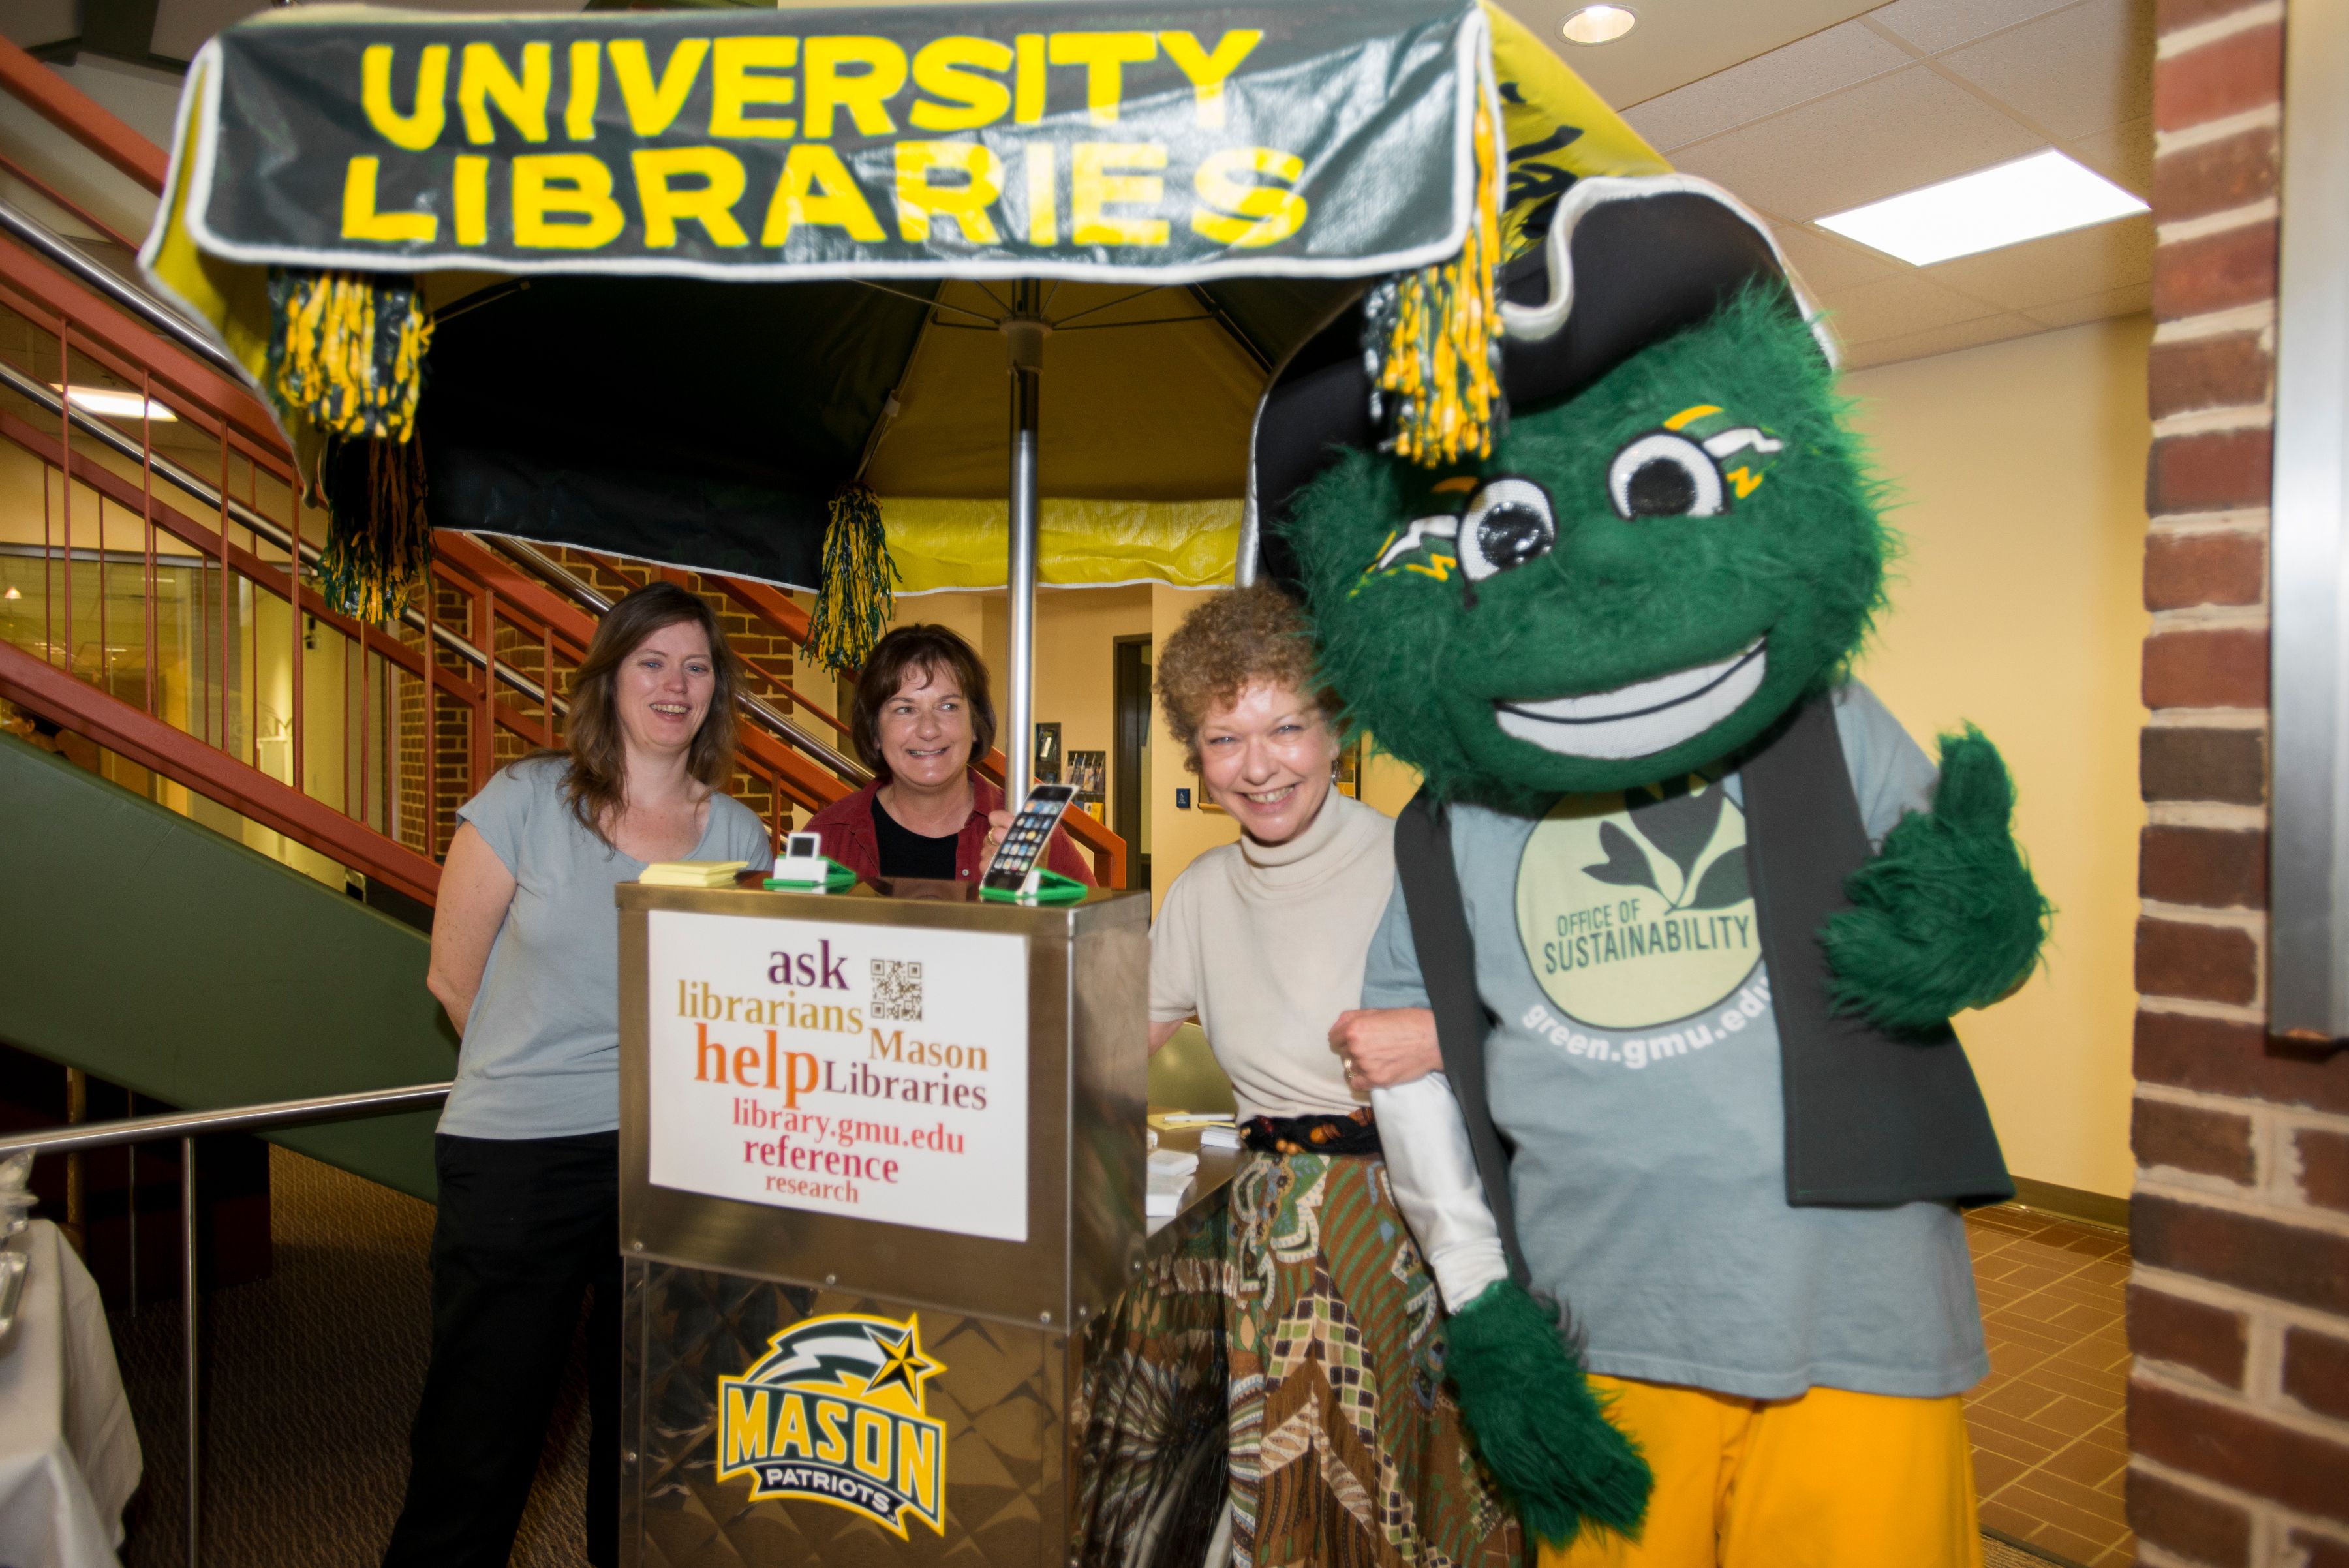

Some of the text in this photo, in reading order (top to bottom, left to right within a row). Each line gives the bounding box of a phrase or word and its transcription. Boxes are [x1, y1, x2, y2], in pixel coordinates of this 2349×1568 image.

[361, 29, 1264, 151] UNIVERSITY
[341, 140, 1308, 249] LIBRARIES
[1557, 898, 1640, 938] OFFICE OF
[767, 939, 850, 991] ask
[1544, 915, 1750, 975] SUSTAINABILITY
[677, 979, 863, 1034] librarians
[694, 1022, 820, 1110] help
[868, 1028, 989, 1071] Mason
[822, 1060, 988, 1111] Libraries
[732, 1098, 966, 1154] library.gmu.edu
[743, 1135, 899, 1184] reference
[765, 1173, 859, 1204] research
[726, 1387, 936, 1515] MASON
[765, 1468, 891, 1513] PATRIOTS
